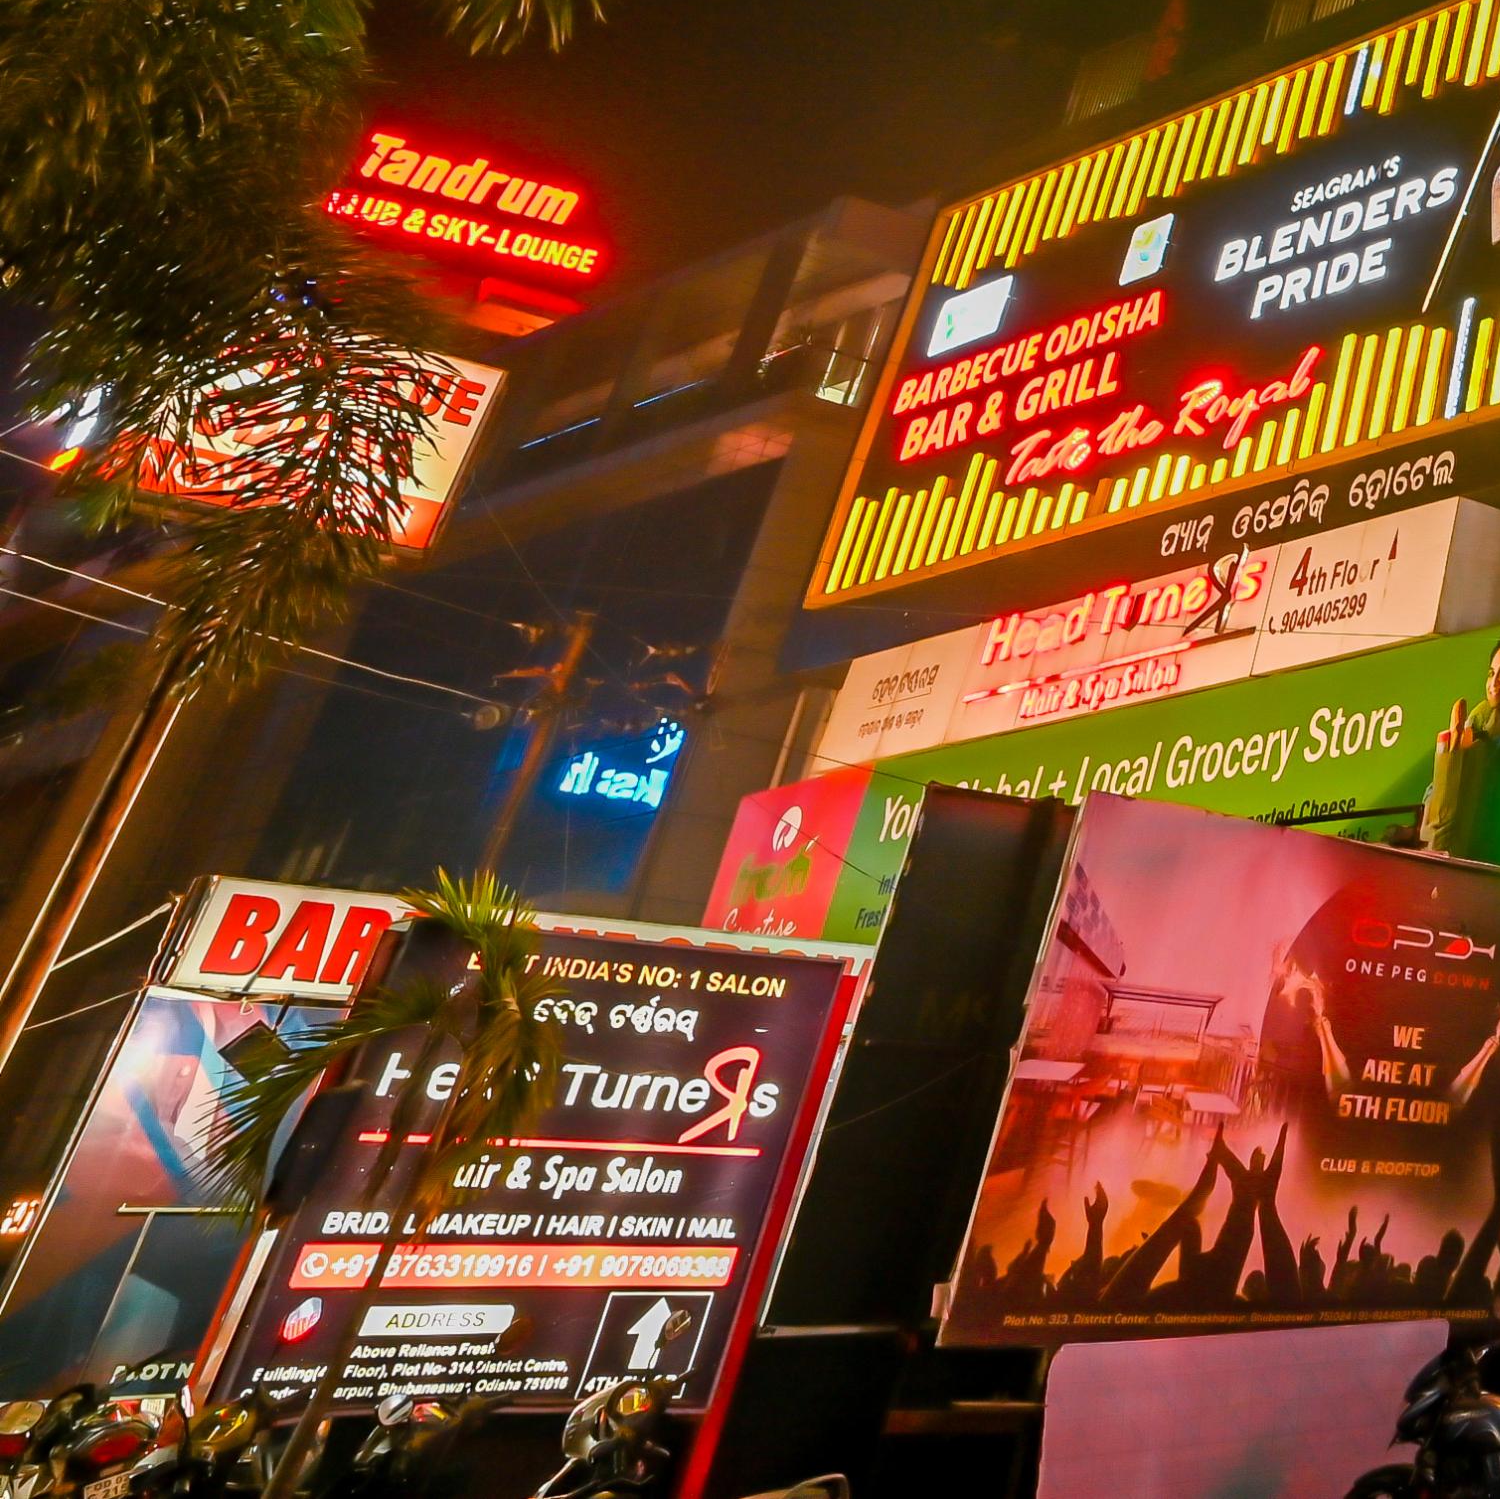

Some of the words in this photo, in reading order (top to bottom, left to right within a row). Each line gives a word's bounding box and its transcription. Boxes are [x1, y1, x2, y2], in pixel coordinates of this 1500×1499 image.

[360, 133, 579, 225] Tandrum
[1291, 156, 1400, 212] SEAGRAM'S
[402, 209, 425, 233] &
[427, 214, 598, 274] SKY-LOUNGE
[1214, 168, 1458, 282] BLENDERS
[1250, 239, 1392, 319] PRIDE
[893, 333, 1038, 416] BARBECUE
[1045, 291, 1161, 358] ODISHA
[900, 404, 978, 462] BAR
[977, 391, 1003, 436] &
[1014, 352, 1119, 422] GRILL
[1097, 405, 1164, 455] the
[1173, 346, 1323, 450] Royal
[1289, 547, 1327, 597] 4th
[1330, 557, 1380, 591] Flor
[981, 591, 1091, 665] Head
[1020, 688, 1060, 718] Hair
[1063, 682, 1080, 709] &
[1081, 670, 1120, 710] Spa
[1121, 659, 1181, 699] Salon
[1072, 757, 1163, 805] Local
[1166, 726, 1299, 788] Grocery
[1304, 705, 1403, 764] Store
[1300, 797, 1357, 819] Cheese
[543, 956, 634, 985] INDIA'S
[638, 965, 684, 989] NO:
[690, 970, 702, 991] 1
[706, 972, 786, 1000] SALON
[1345, 959, 1385, 977] ONE
[1391, 965, 1427, 982] PEG
[1434, 972, 1490, 990] DOWN
[1393, 1025, 1425, 1050] WE
[1361, 1058, 1404, 1084] ARE
[1408, 1063, 1436, 1086] AT
[1338, 1094, 1381, 1119] 5TH
[1385, 1098, 1449, 1125] FLOOR
[506, 1156, 532, 1190] &
[540, 1155, 597, 1199] Spa
[602, 1157, 683, 1194] Salon
[1320, 1158, 1357, 1173] CLUB
[1361, 1160, 1370, 1173] &
[1375, 1162, 1440, 1176] ROOFTOP
[321, 1211, 416, 1234] BRIDL
[425, 1213, 531, 1236] MAKEUP
[546, 1215, 604, 1236] HAIR
[619, 1216, 674, 1237] SKIN
[687, 1218, 736, 1238] NAIL
[331, 1253, 378, 1278] +91
[553, 1255, 595, 1278] +91
[386, 1311, 486, 1329] ADDRESS
[110, 1363, 175, 1384] POT
[350, 1345, 396, 1360] Above
[399, 1343, 456, 1359] Reliance
[392, 1362, 420, 1377] Plot
[475, 1380, 521, 1394] Odisha
